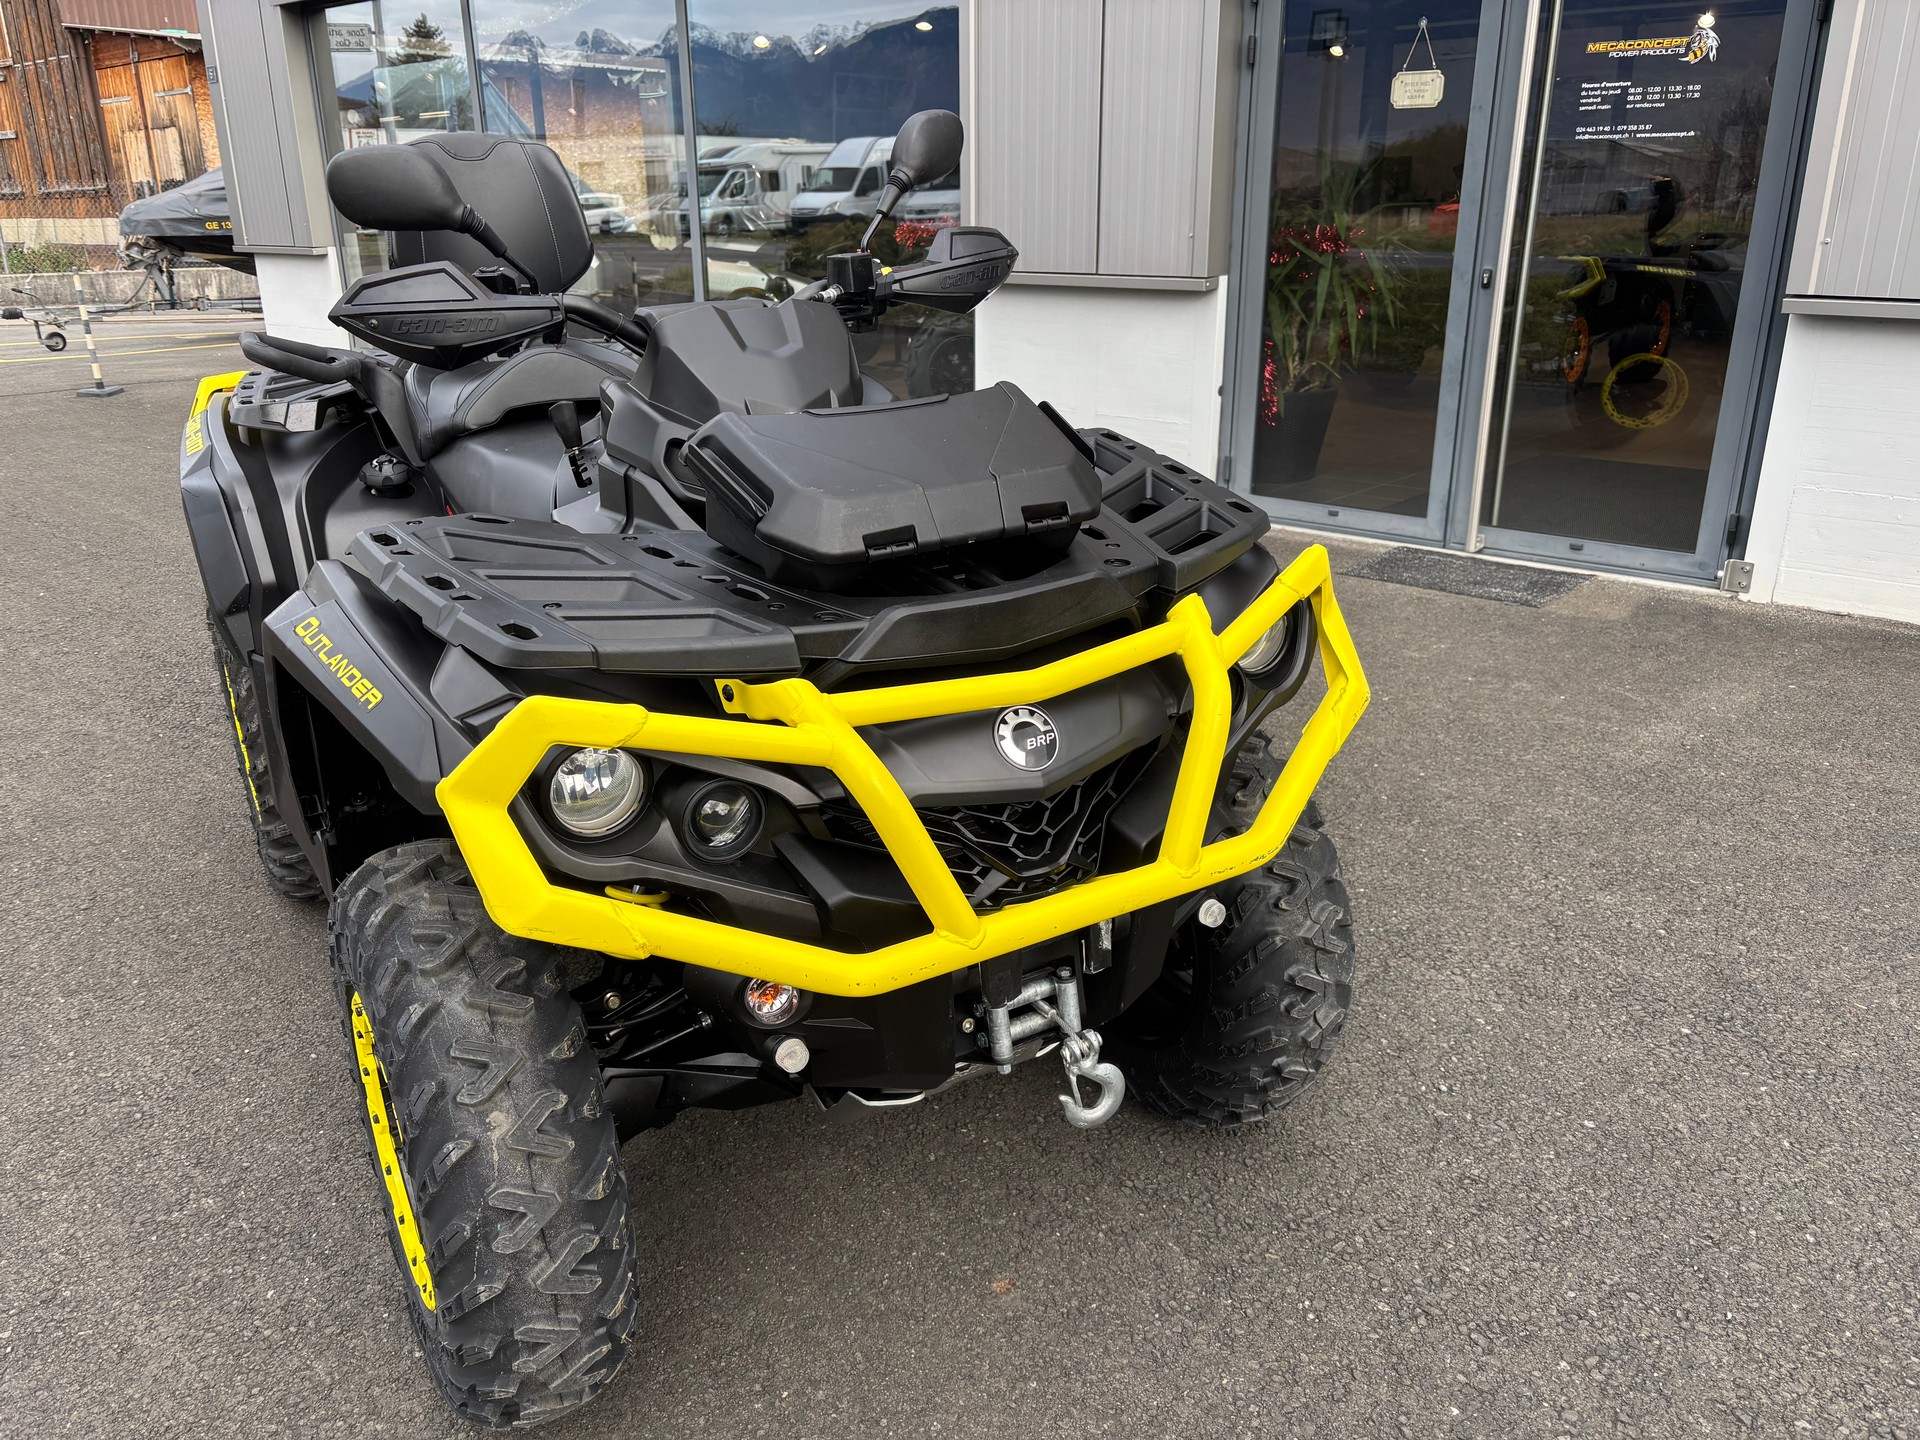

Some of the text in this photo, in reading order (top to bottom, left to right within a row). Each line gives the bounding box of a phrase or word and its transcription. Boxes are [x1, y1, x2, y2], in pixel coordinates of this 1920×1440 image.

[1586, 37, 1690, 53] MECACONCEPT
[1608, 47, 1686, 58] POWER PRODUCTS
[1608, 88, 1621, 96] jeudi
[1635, 130, 1695, 138] www.mecaconcept.ch
[205, 221, 220, 230] GE
[941, 265, 1000, 289] can-am
[391, 317, 499, 334] can-am
[1026, 732, 1055, 751] BRP
